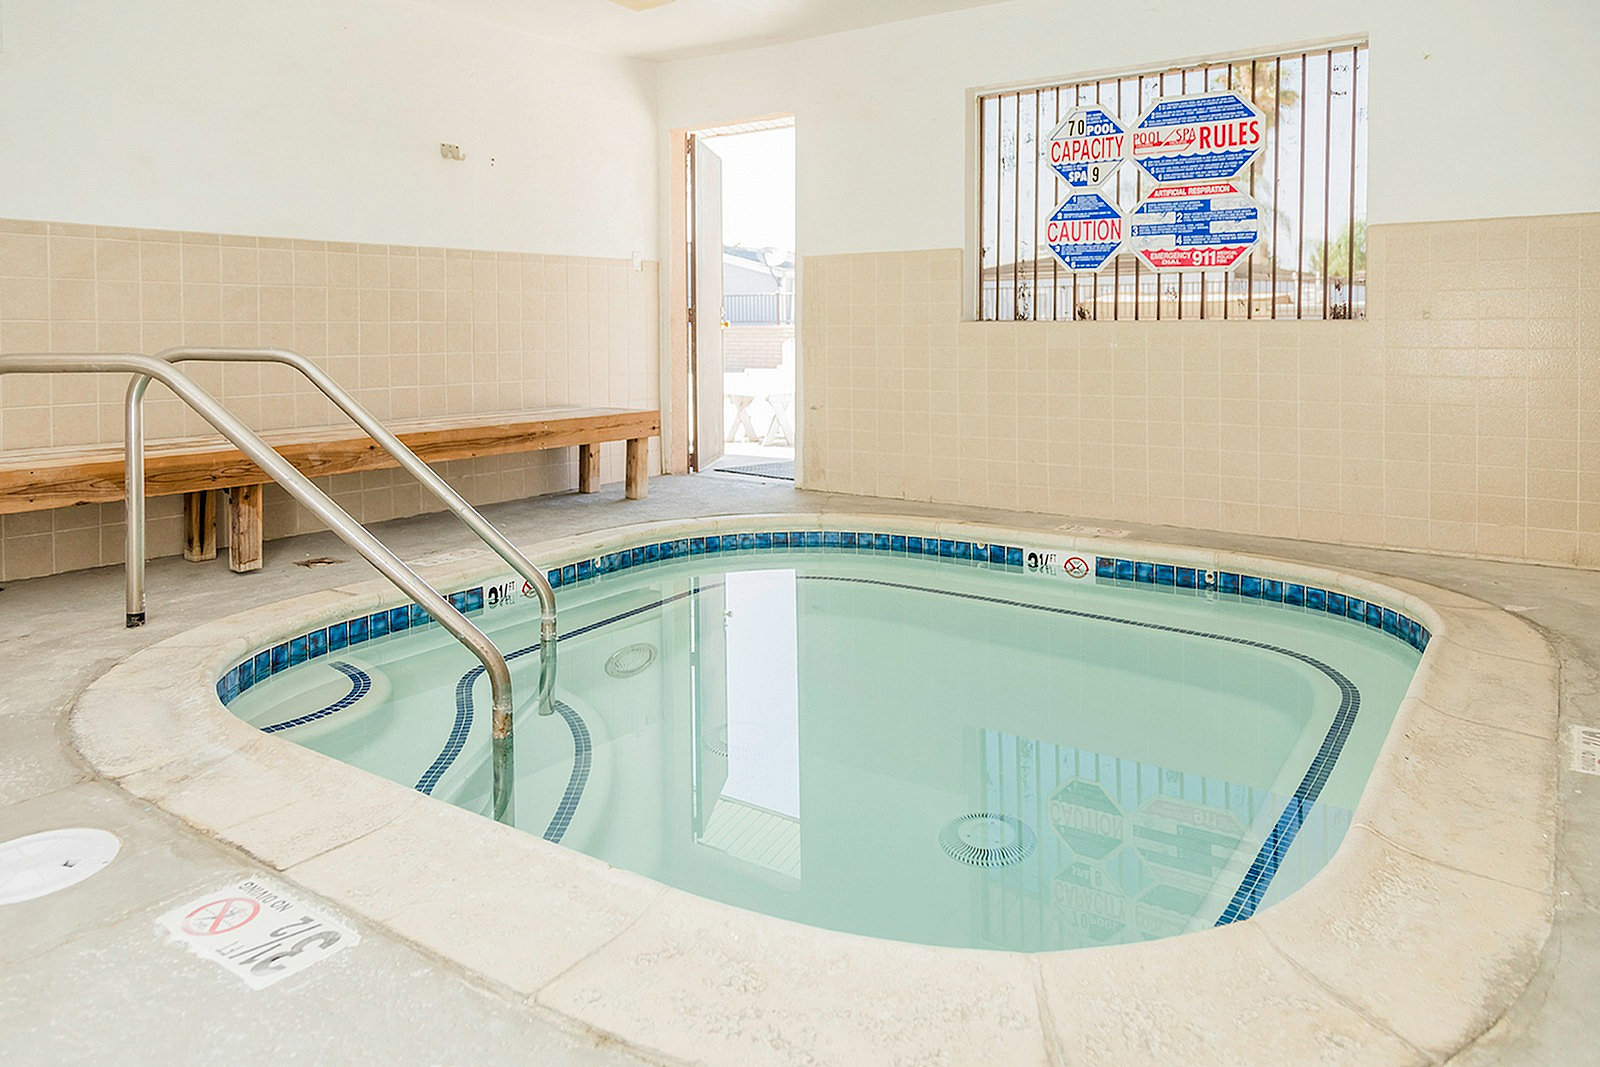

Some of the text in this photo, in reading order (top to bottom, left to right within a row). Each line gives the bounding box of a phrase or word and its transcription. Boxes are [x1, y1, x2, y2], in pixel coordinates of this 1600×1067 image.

[1068, 120, 1116, 136] 70 POOL
[1133, 131, 1162, 146] POOL
[1175, 127, 1197, 142] SPA
[1199, 120, 1260, 150] RULES
[1051, 135, 1124, 163] CAPACITY
[1068, 170, 1087, 182] SPA
[1092, 166, 1100, 183] 9
[1153, 184, 1231, 197] ARTIFICIAL RESPIRATION
[1176, 213, 1183, 223] 2
[1047, 219, 1122, 242] CAUTION
[1132, 225, 1138, 236] 3
[1176, 235, 1182, 245] 4
[1150, 250, 1191, 260] EMERGENCY
[1191, 250, 1216, 266] 911
[238, 881, 294, 913] NO DIVING
